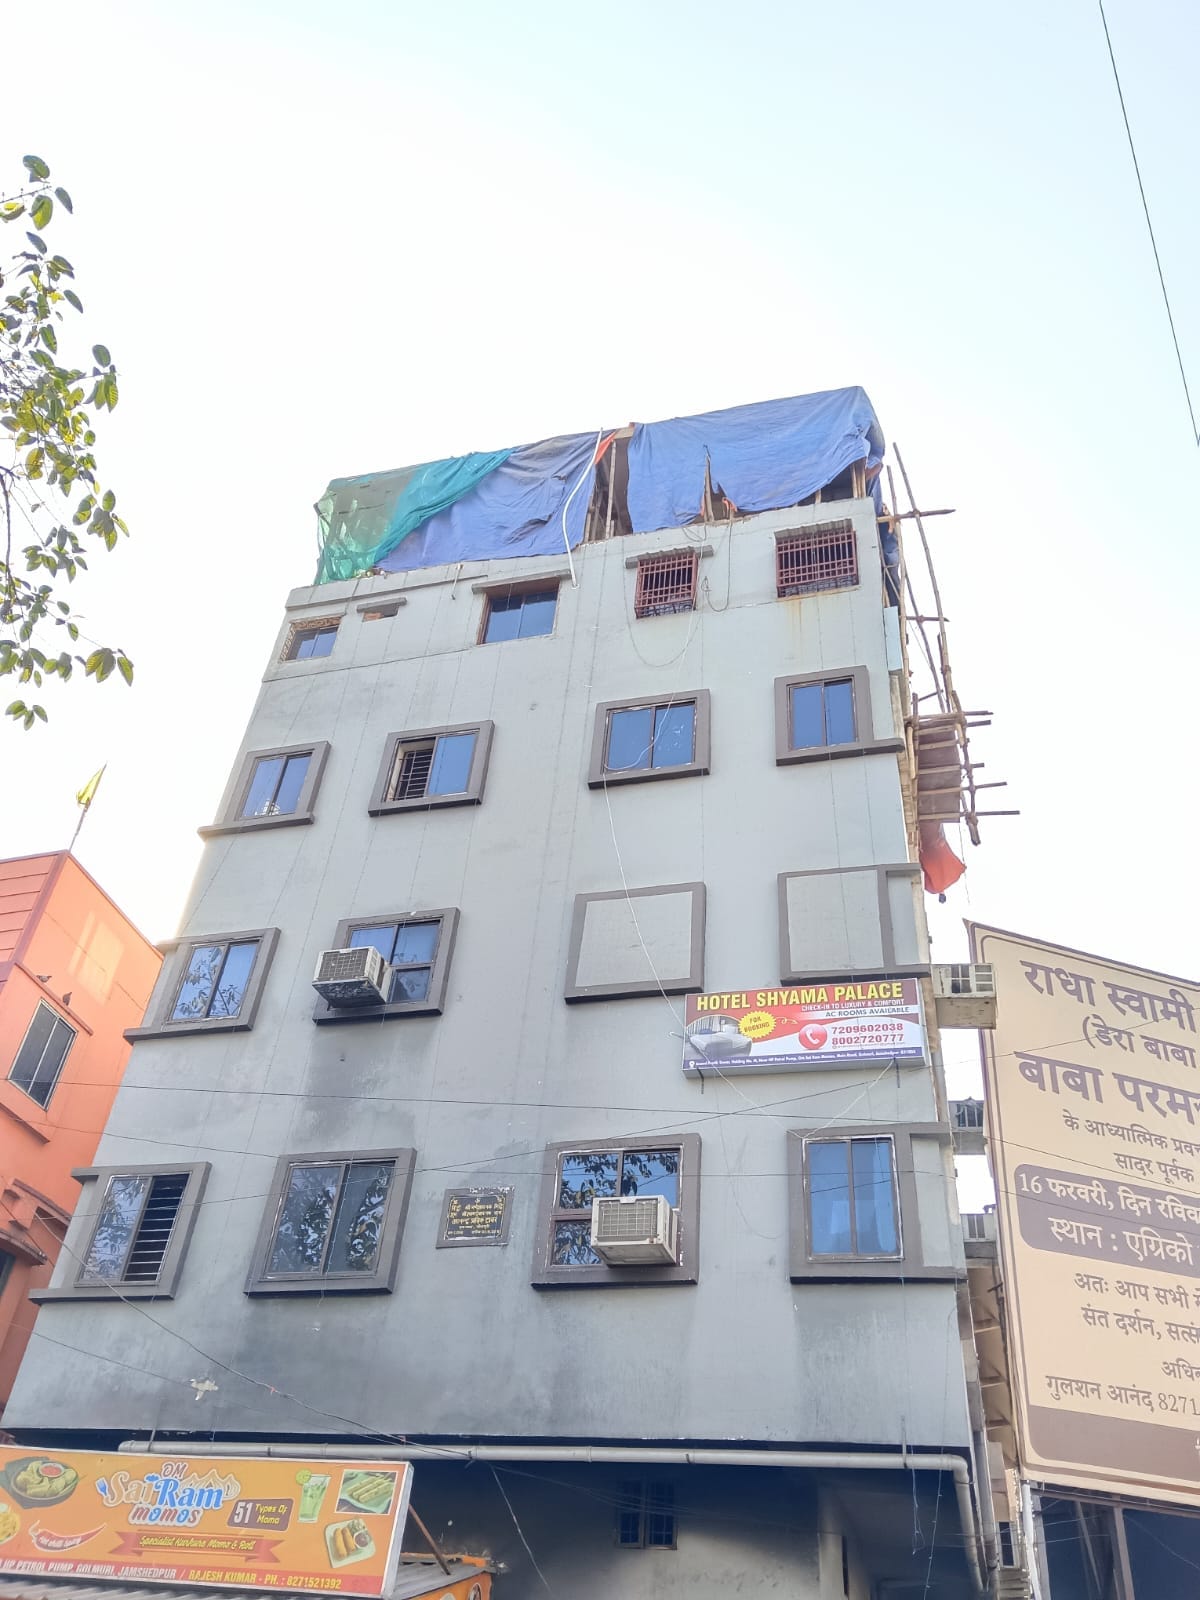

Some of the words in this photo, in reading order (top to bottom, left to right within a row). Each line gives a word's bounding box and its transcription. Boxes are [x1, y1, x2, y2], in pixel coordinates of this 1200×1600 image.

[697, 994, 750, 1010] HOTEL
[758, 988, 828, 1007] SHYAMA
[835, 982, 902, 1000] PALACE
[802, 1004, 829, 1012] CHECK-IN
[870, 1006, 910, 1014] AVAILABLE
[1020, 960, 1096, 1006] राधा
[1102, 981, 1196, 1033] स्वामी
[744, 1022, 770, 1032] BOOKING
[832, 1023, 904, 1034] 7209602038
[832, 1034, 904, 1046] 8002720777
[1082, 1014, 1134, 1053] (डेरा
[1140, 1034, 1196, 1068] बाबा
[1014, 1051, 1104, 1104] बाबा
[1062, 1108, 1080, 1130] के
[1084, 1120, 1168, 1148] आध्यात्मिक
[1113, 1152, 1154, 1176] सादर
[1156, 1158, 1194, 1184] पूर्वक
[1018, 1173, 1042, 1194] 16
[1045, 1178, 1114, 1210] फरवरी,
[1117, 1186, 1152, 1216] दिन
[1048, 1218, 1102, 1248] स्थान
[1122, 1227, 1194, 1266] एग्रिको
[1114, 1280, 1150, 1301] आप
[1152, 1285, 1190, 1309] सभी
[1080, 1304, 1110, 1328] संत
[1113, 1309, 1162, 1340] दर्शन,
[1046, 1375, 1102, 1400] गुलशन
[1106, 1384, 1154, 1412] आनंद
[163, 1463, 187, 1477] OM
[104, 1472, 155, 1506] Sai
[154, 1478, 224, 1508] Ram
[132, 1506, 200, 1524] momos
[234, 1502, 253, 1524] 51
[256, 1504, 276, 1514] Types
[140, 1536, 174, 1546] Specialist
[4, 1560, 16, 1568] HP
[16, 1560, 45, 1572] PETROL
[118, 1566, 177, 1578] JAMSHEDPUR
[189, 1570, 222, 1582] RAJESH
[224, 1572, 256, 1583] KUMAR
